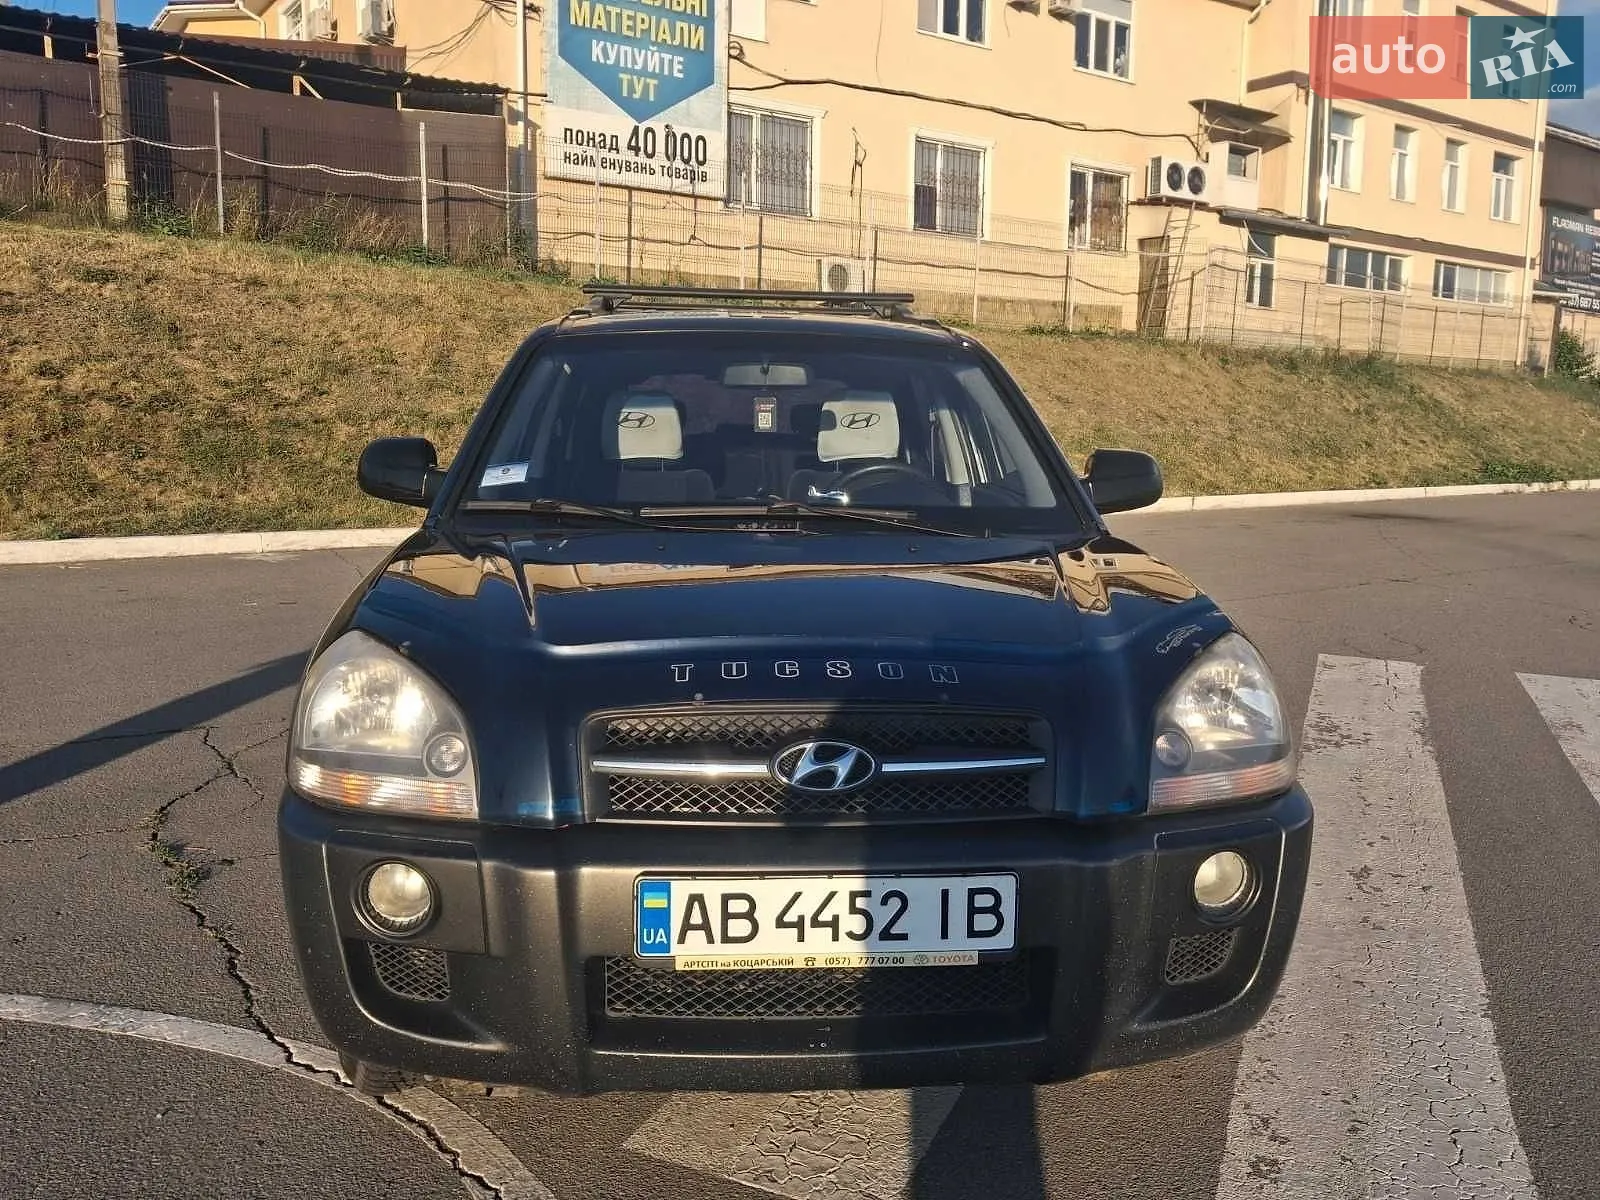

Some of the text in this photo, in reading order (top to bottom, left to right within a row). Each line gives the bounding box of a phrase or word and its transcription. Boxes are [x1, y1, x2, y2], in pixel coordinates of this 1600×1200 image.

[569, 0, 705, 51] МАТЕРІАЛИ
[591, 39, 685, 79] КУПУЙТЕ
[618, 74, 658, 101] ТУТ
[563, 125, 708, 167] понад 40 000
[660, 164, 708, 184] товарів
[671, 660, 960, 683] TUCSON
[676, 887, 1005, 945] AB 4452 IB
[643, 929, 668, 945] UA
[733, 957, 794, 968] КОЦАРСЬКІЙ
[824, 956, 851, 966] (057)
[857, 956, 875, 965] 777
[878, 956, 889, 965] 07
[892, 956, 904, 965] 00
[933, 954, 975, 964] TOYOTA
